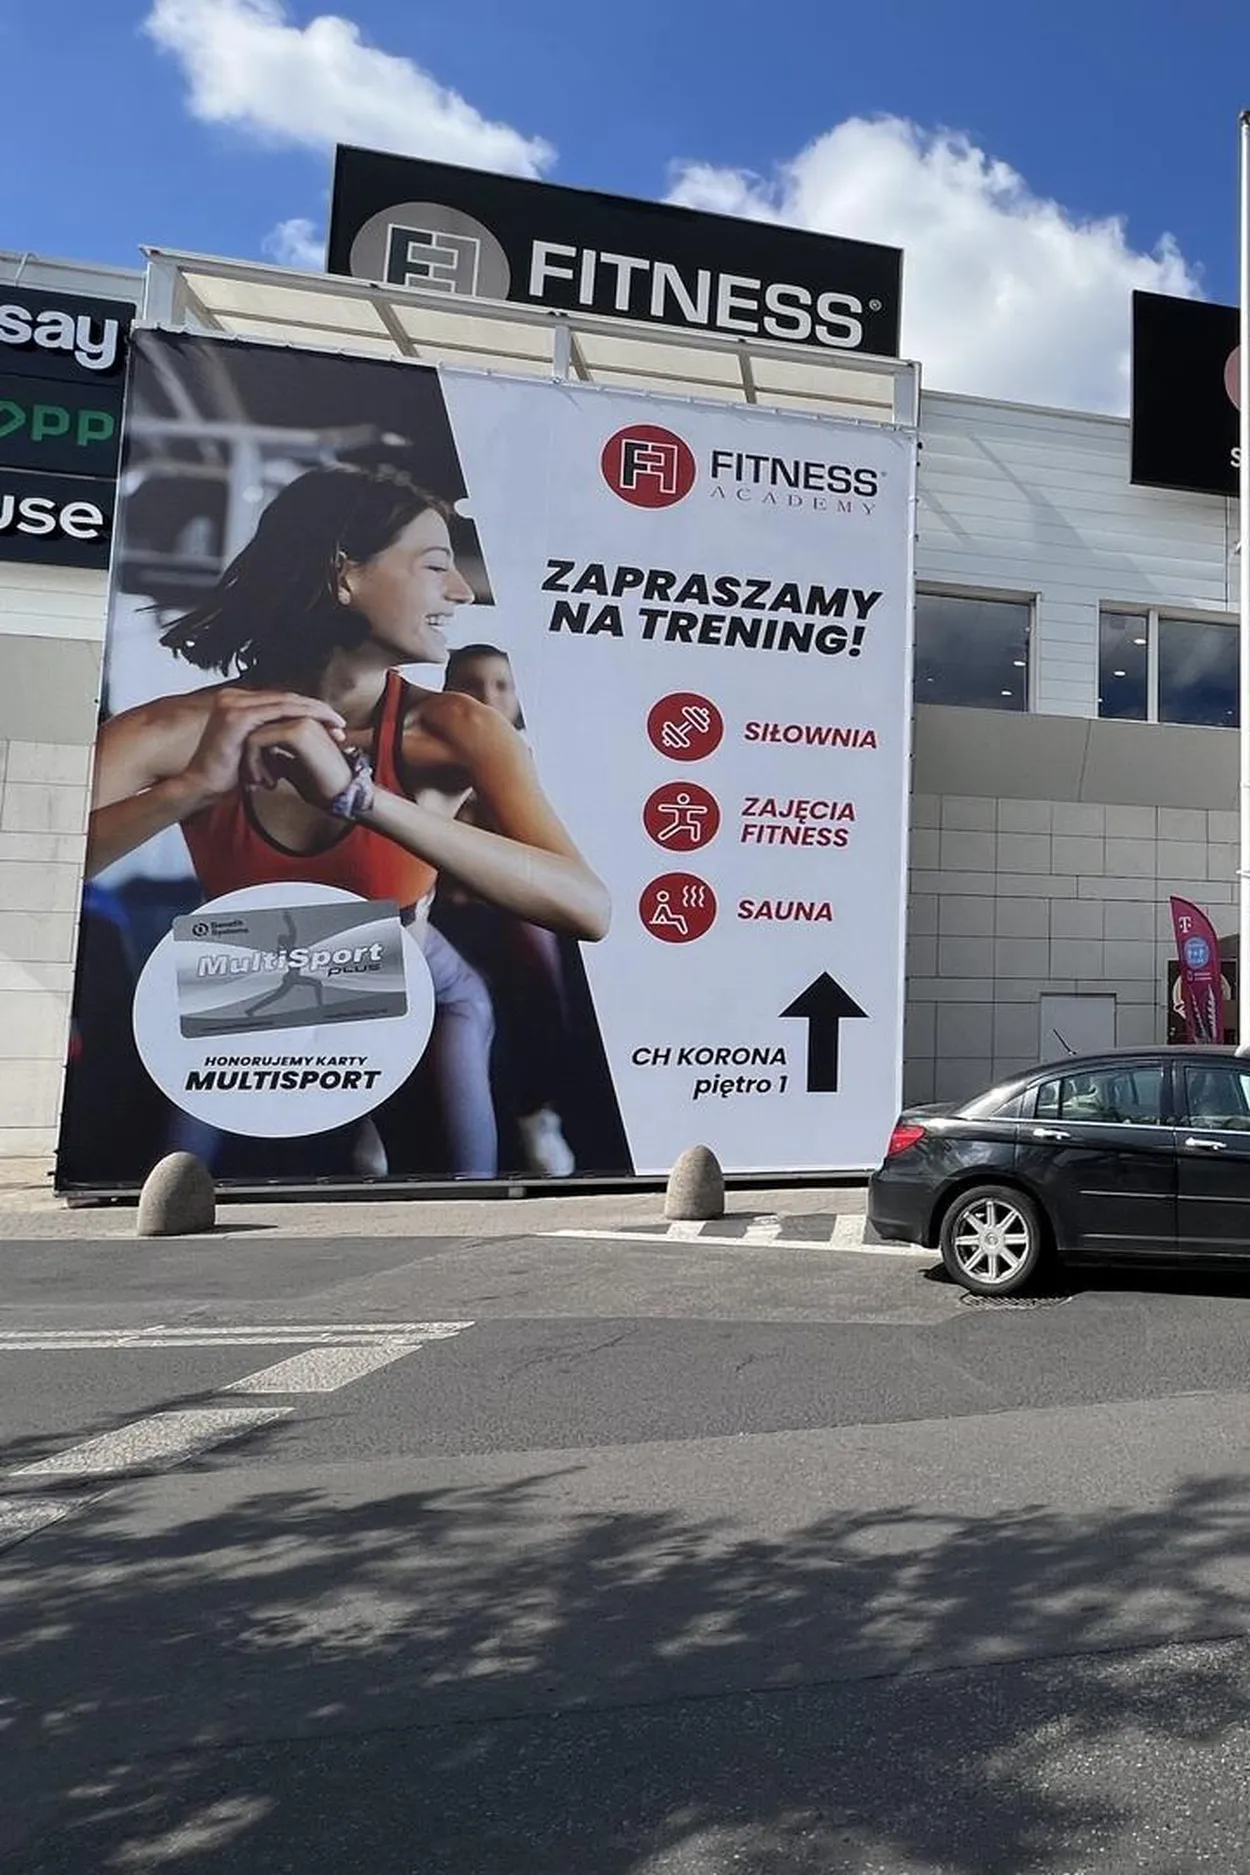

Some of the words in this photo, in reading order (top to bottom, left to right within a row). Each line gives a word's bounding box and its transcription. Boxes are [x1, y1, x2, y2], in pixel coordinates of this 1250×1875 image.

[0, 304, 118, 370] say
[541, 559, 883, 620] ZAPRASZAMY
[549, 601, 624, 637] NA
[639, 608, 866, 657] TRENING!
[744, 721, 877, 749] SIŁOWNIA
[741, 797, 856, 825] ZAJĘCIA
[740, 824, 850, 847] FITNESS
[737, 900, 833, 921] SAUNA
[198, 943, 384, 977] MultiSport
[205, 1056, 314, 1067] HONORUJEMY
[316, 1056, 367, 1066] KARTY
[632, 1047, 671, 1066] CH
[677, 1047, 787, 1066] KORONA
[185, 1070, 382, 1091] MULTISPORT
[693, 1073, 771, 1100] piętro
[779, 1075, 788, 1093] 1
